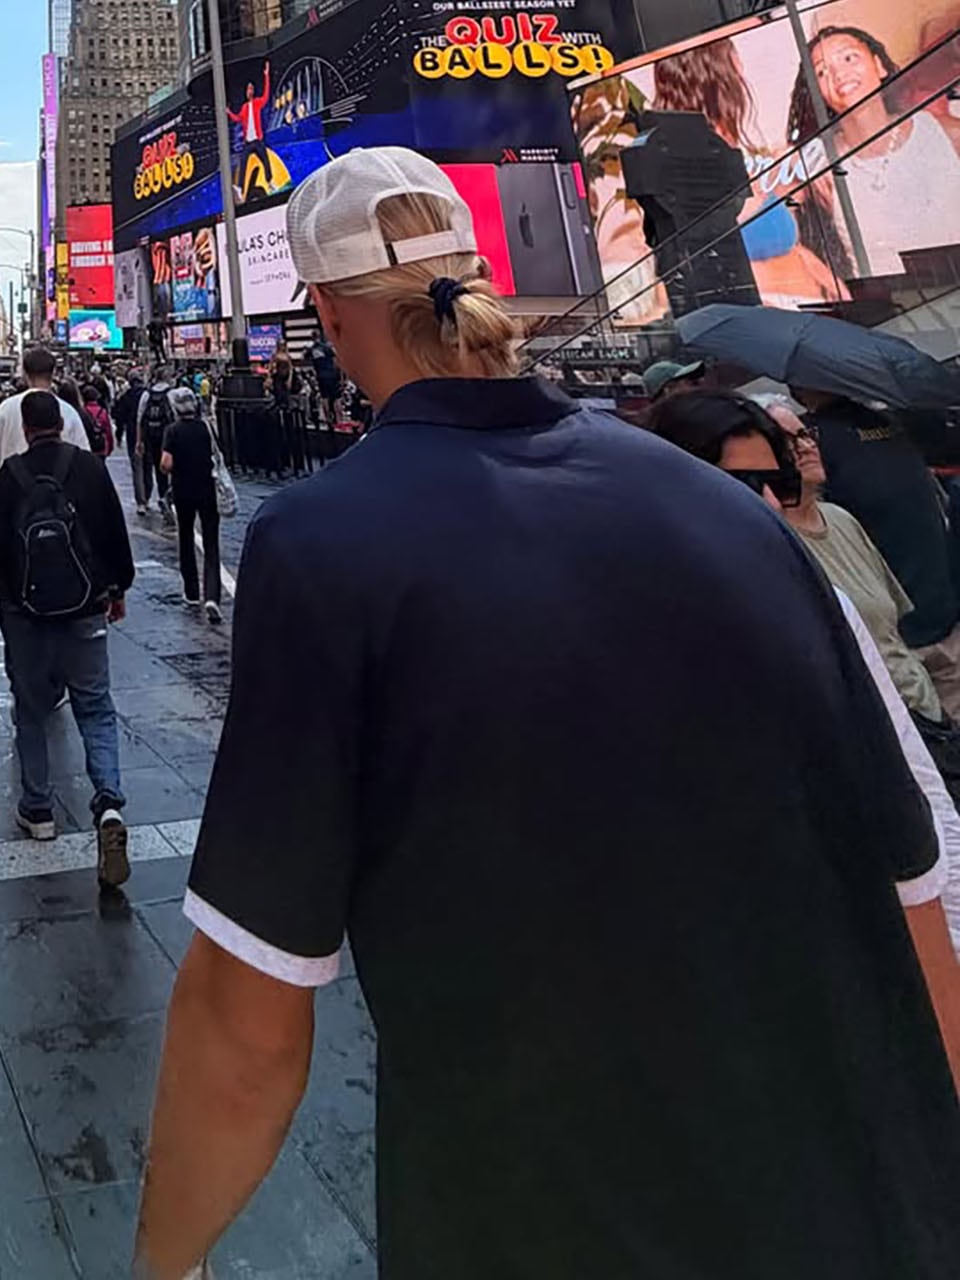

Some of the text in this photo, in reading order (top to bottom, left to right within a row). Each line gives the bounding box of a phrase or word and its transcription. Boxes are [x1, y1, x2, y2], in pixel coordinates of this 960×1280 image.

[433, 2, 455, 11] OUR
[514, 0, 554, 10] SEASON
[557, 0, 576, 8] YET
[420, 13, 602, 48] THE QUIZ WITH
[417, 43, 608, 74] BALLS!
